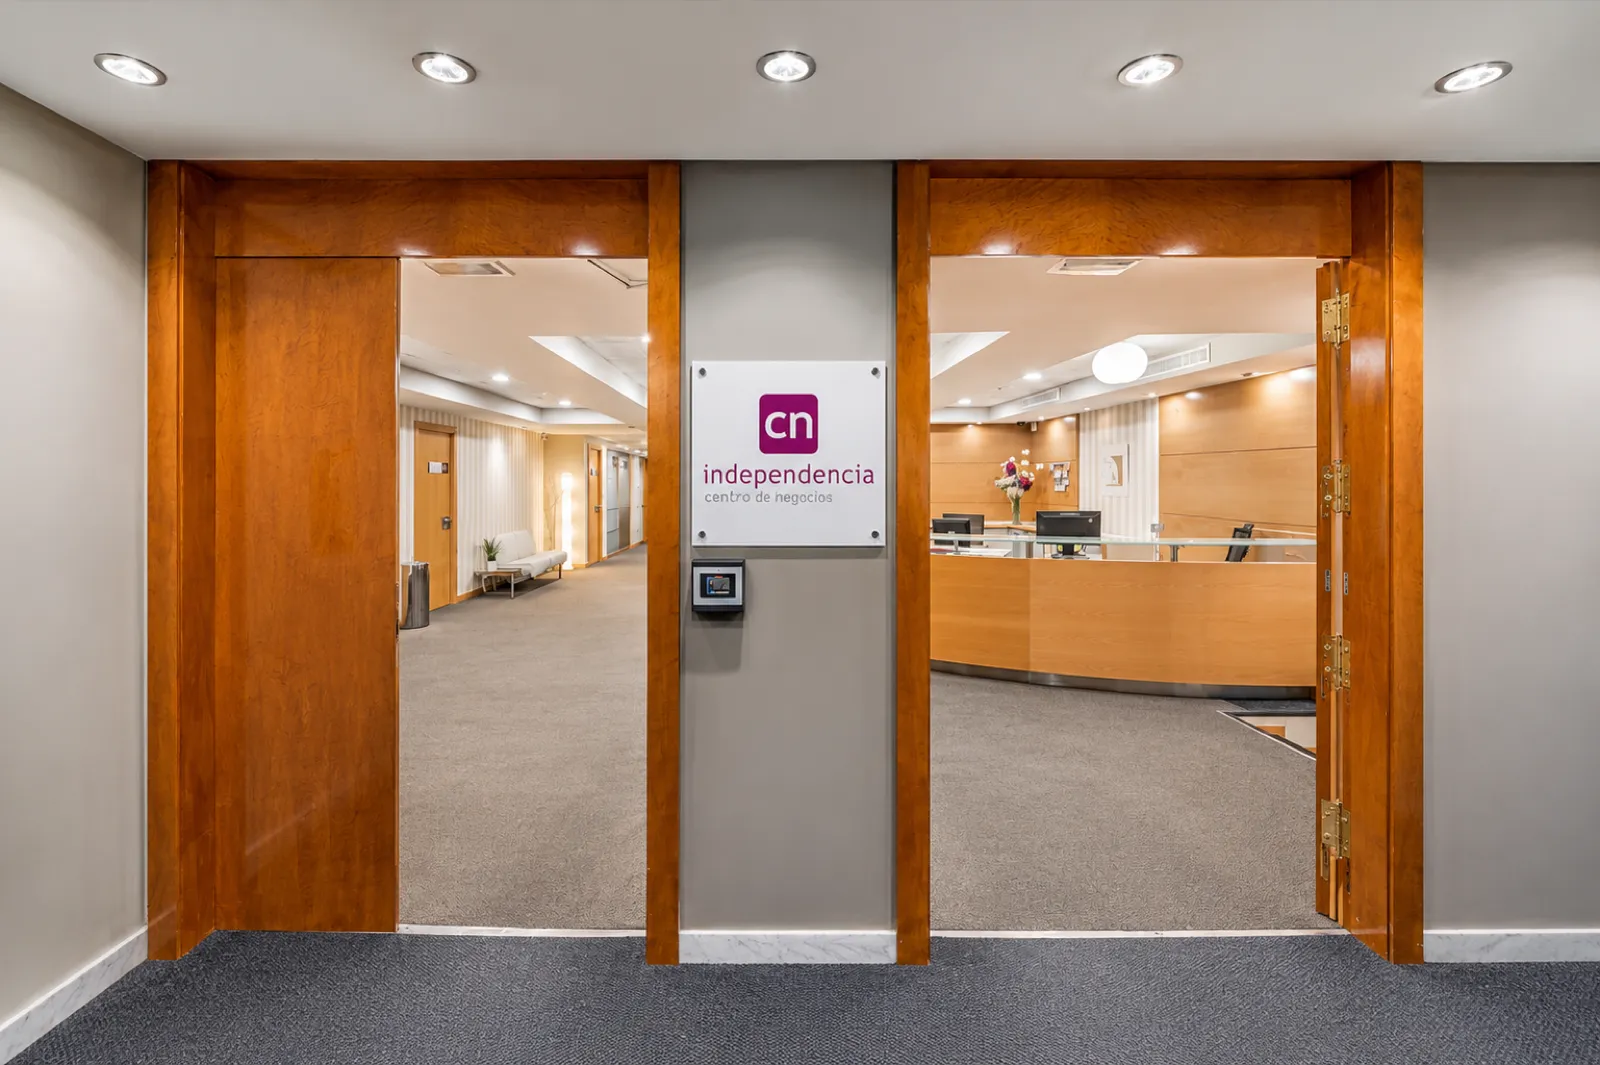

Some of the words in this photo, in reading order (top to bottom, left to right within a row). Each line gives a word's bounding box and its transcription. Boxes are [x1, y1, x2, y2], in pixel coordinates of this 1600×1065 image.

[764, 411, 813, 439] cn
[703, 463, 875, 489] independencia
[704, 490, 751, 503] centro
[755, 490, 771, 503] de
[774, 490, 833, 506] negocios
